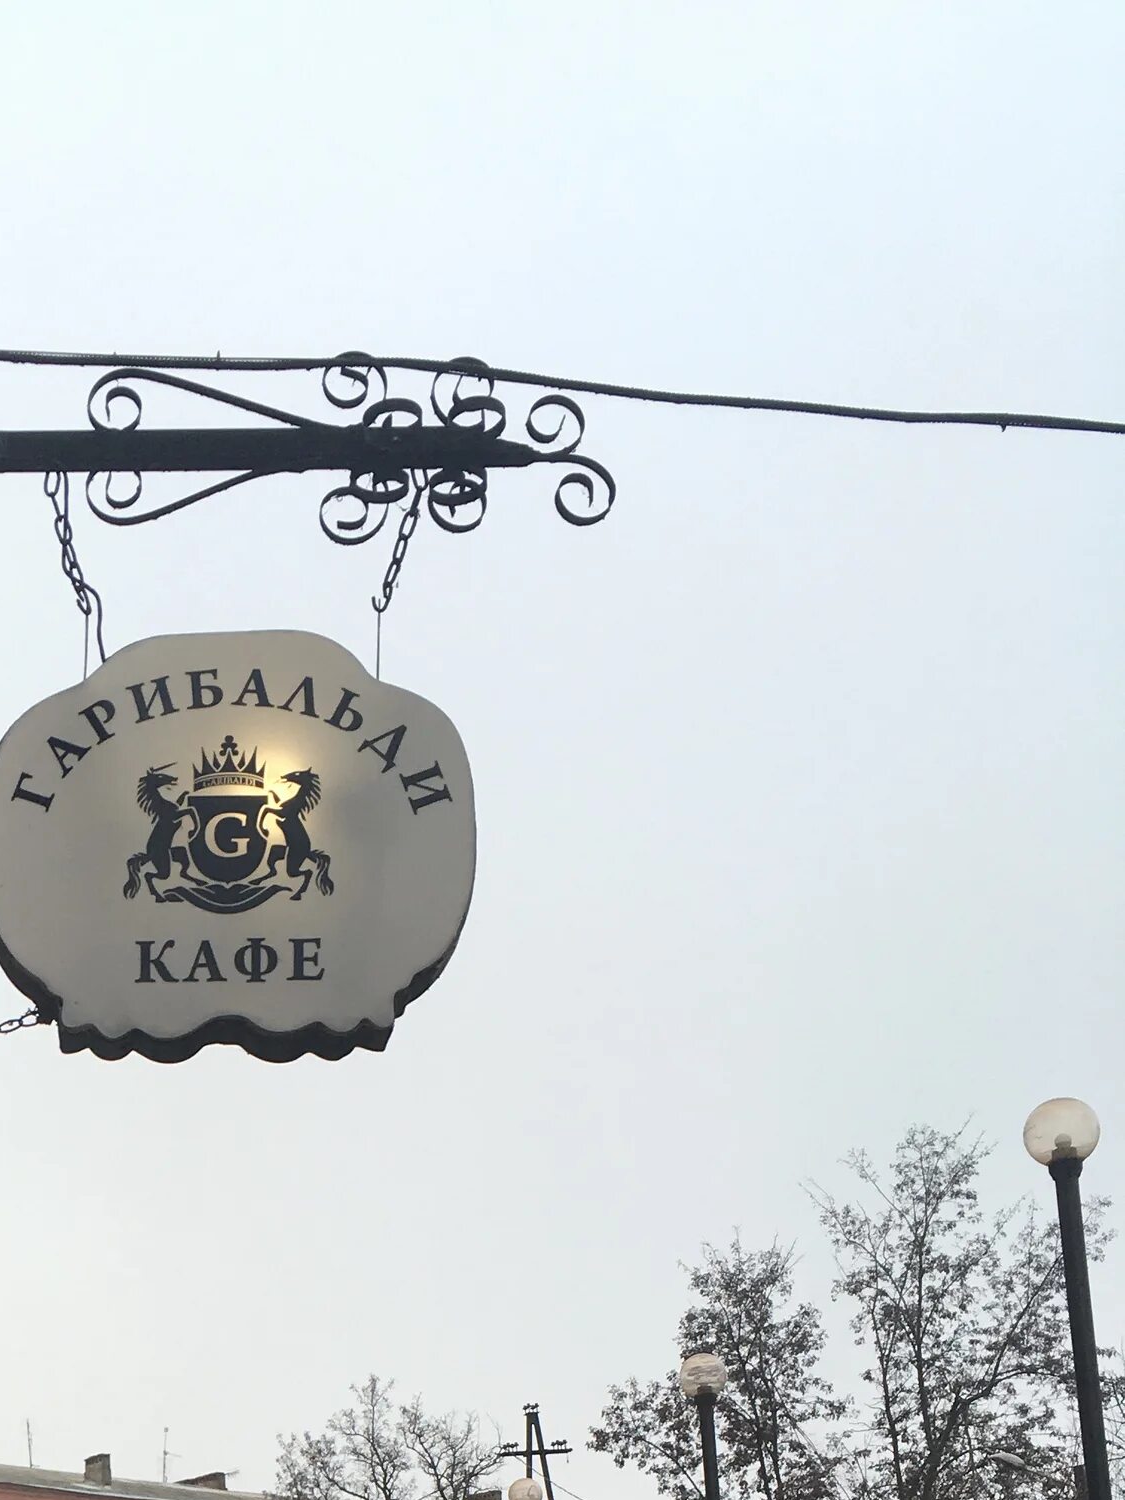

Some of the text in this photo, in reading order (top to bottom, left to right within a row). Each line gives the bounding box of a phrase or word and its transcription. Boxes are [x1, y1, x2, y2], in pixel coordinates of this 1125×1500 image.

[11, 668, 453, 815] ГАРИБАЛЬДИ
[204, 812, 250, 858] G
[134, 937, 325, 984] КАФЕ
